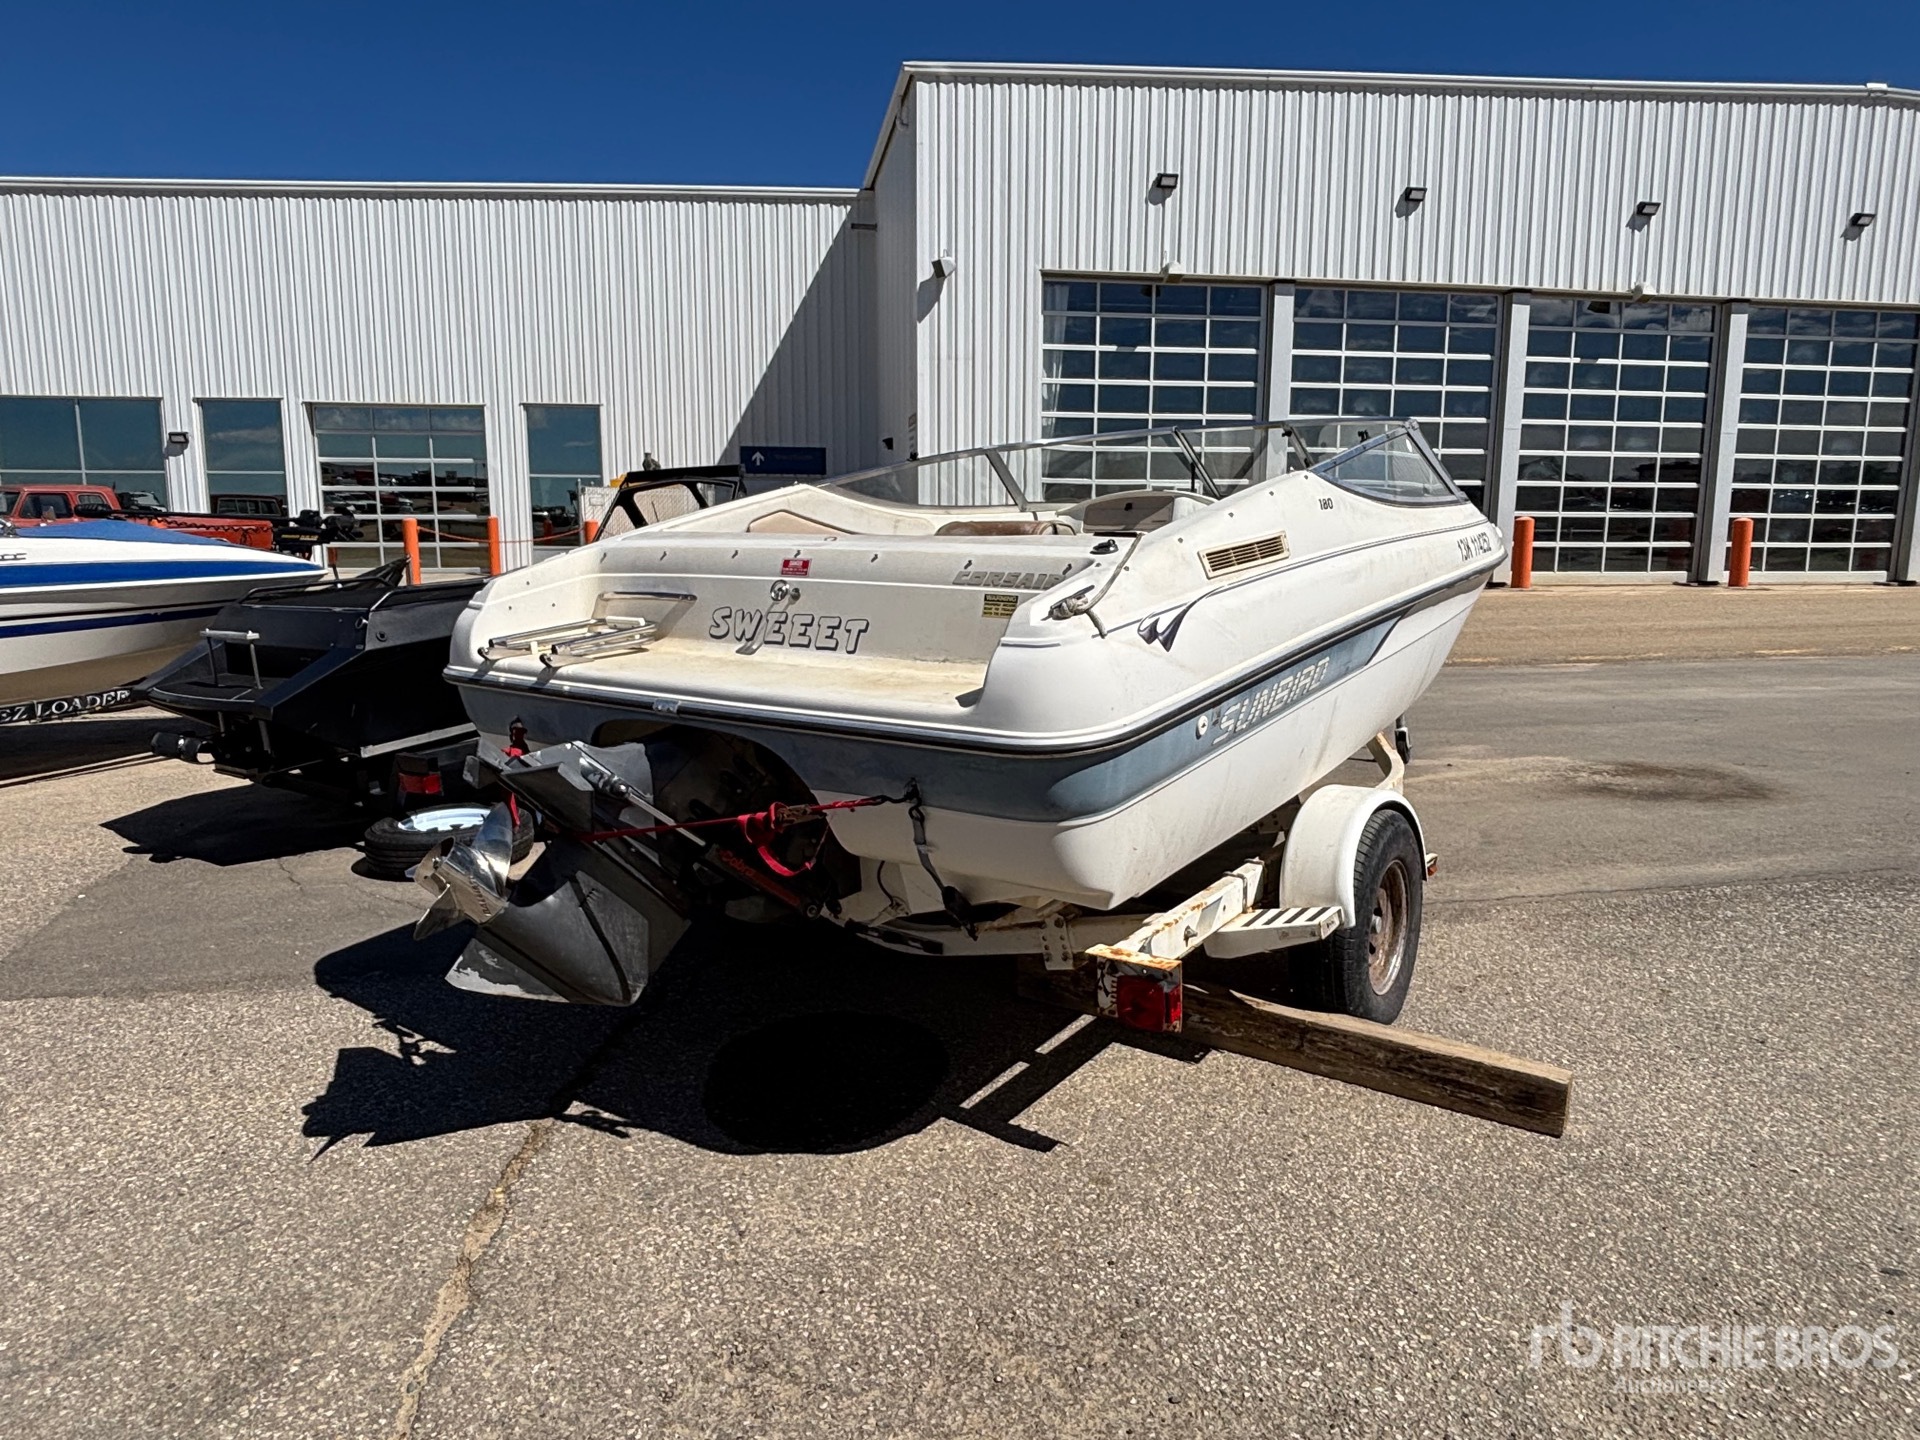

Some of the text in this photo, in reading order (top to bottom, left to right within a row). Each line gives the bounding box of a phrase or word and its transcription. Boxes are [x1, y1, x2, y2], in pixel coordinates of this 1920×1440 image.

[1318, 497, 1333, 510] 180
[709, 606, 869, 655] SWEEET
[1211, 656, 1330, 746] SUNBIRD
